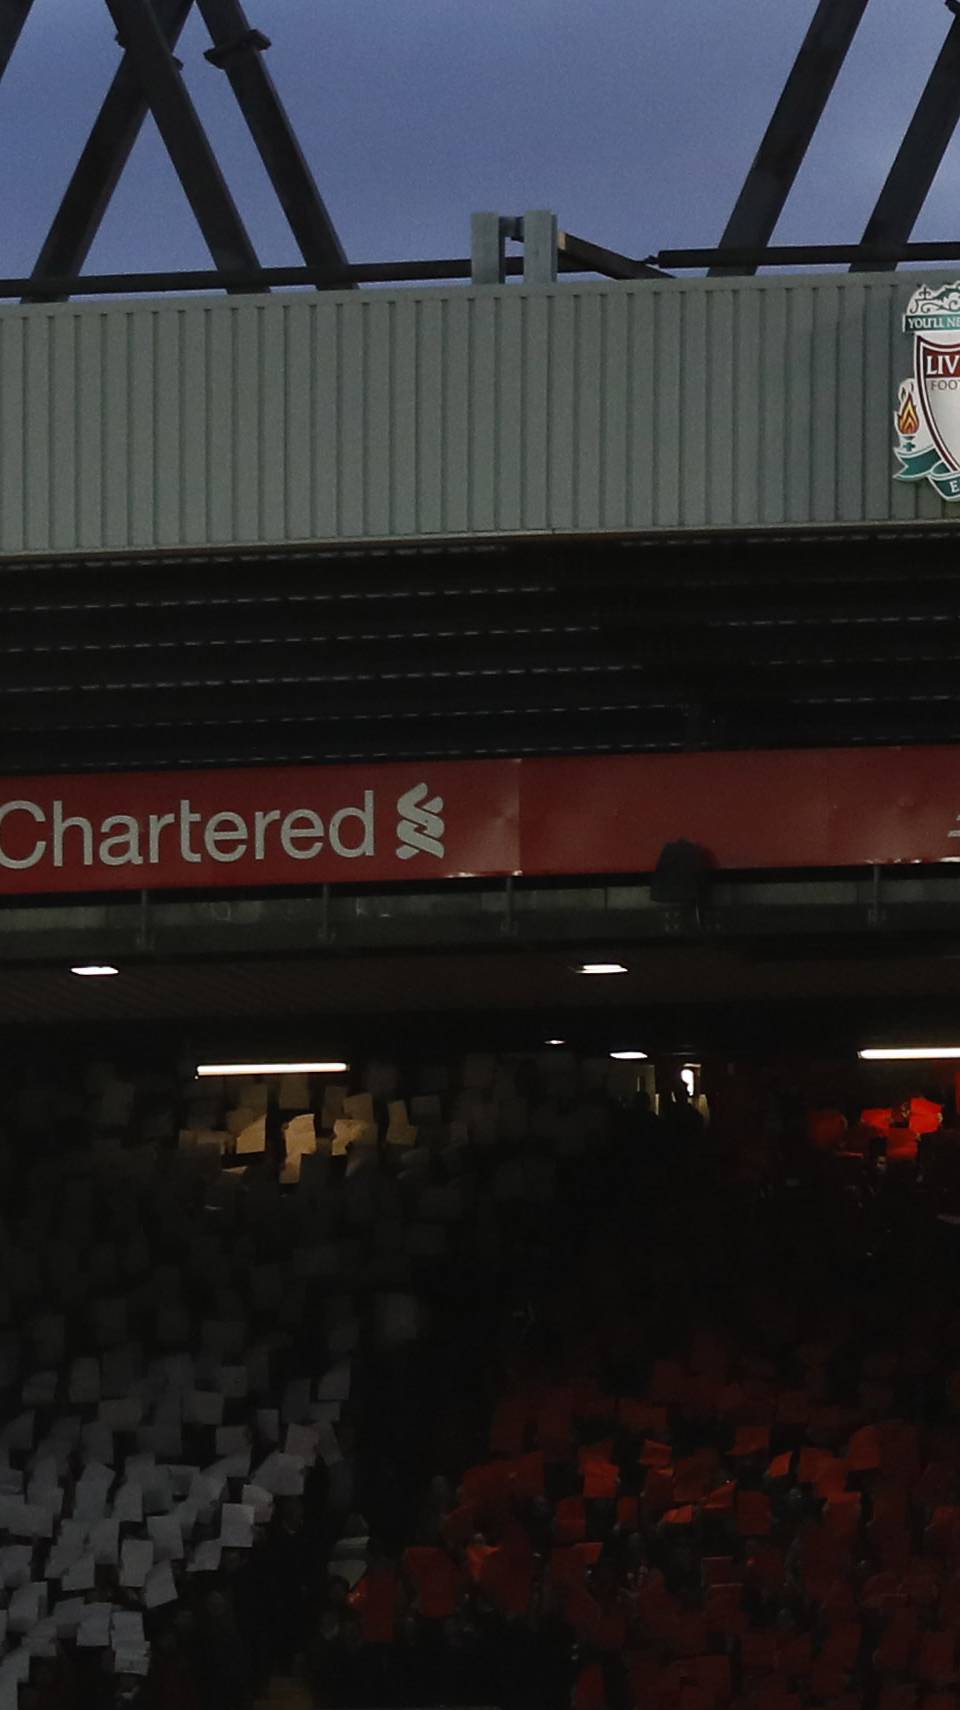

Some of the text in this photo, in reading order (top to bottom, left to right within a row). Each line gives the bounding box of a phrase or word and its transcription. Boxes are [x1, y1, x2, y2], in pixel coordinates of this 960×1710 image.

[907, 317, 945, 329] YOU'LL
[926, 354, 960, 375] LIV
[930, 379, 960, 391] FOO
